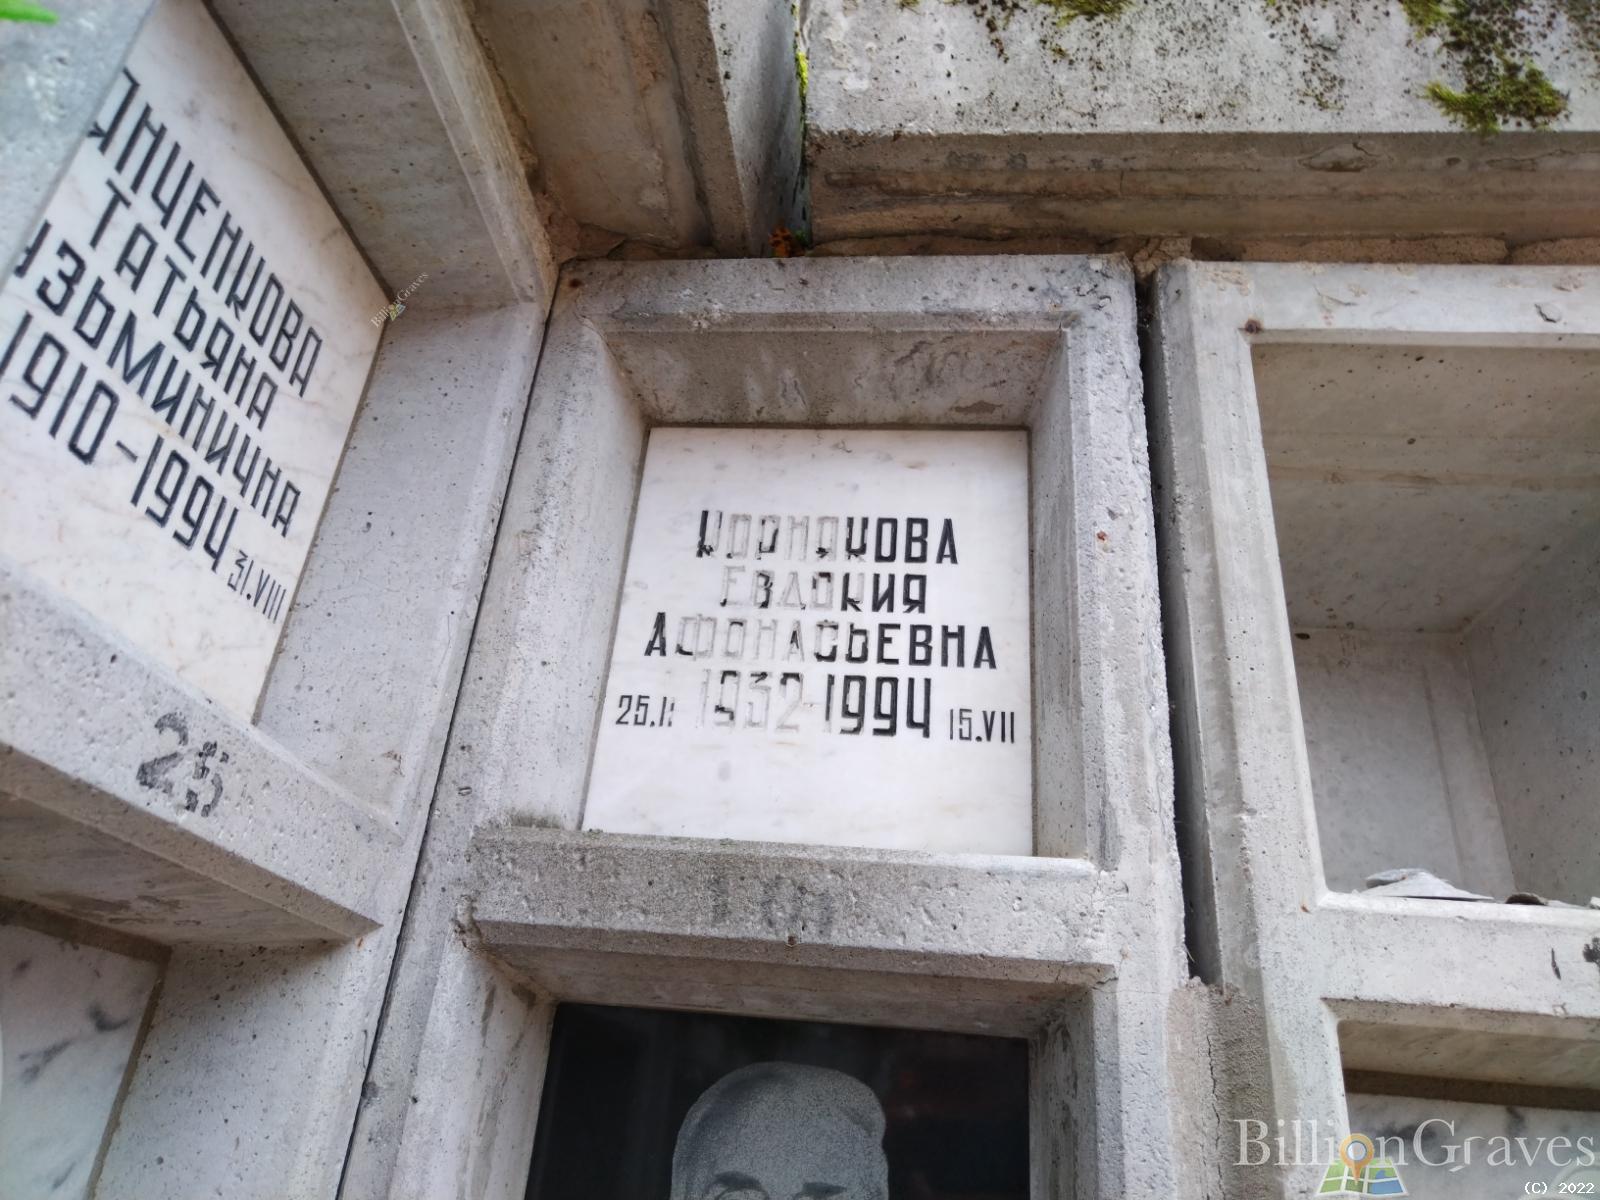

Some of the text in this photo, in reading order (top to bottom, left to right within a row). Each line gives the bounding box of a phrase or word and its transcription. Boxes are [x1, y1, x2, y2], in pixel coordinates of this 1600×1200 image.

[89, 178, 278, 430] ТАТЬЯНА
[227, 549, 287, 624] 31.VIII
[719, 565, 928, 614] ЕВДОКИЯ
[949, 708, 1016, 744] 15.VII
